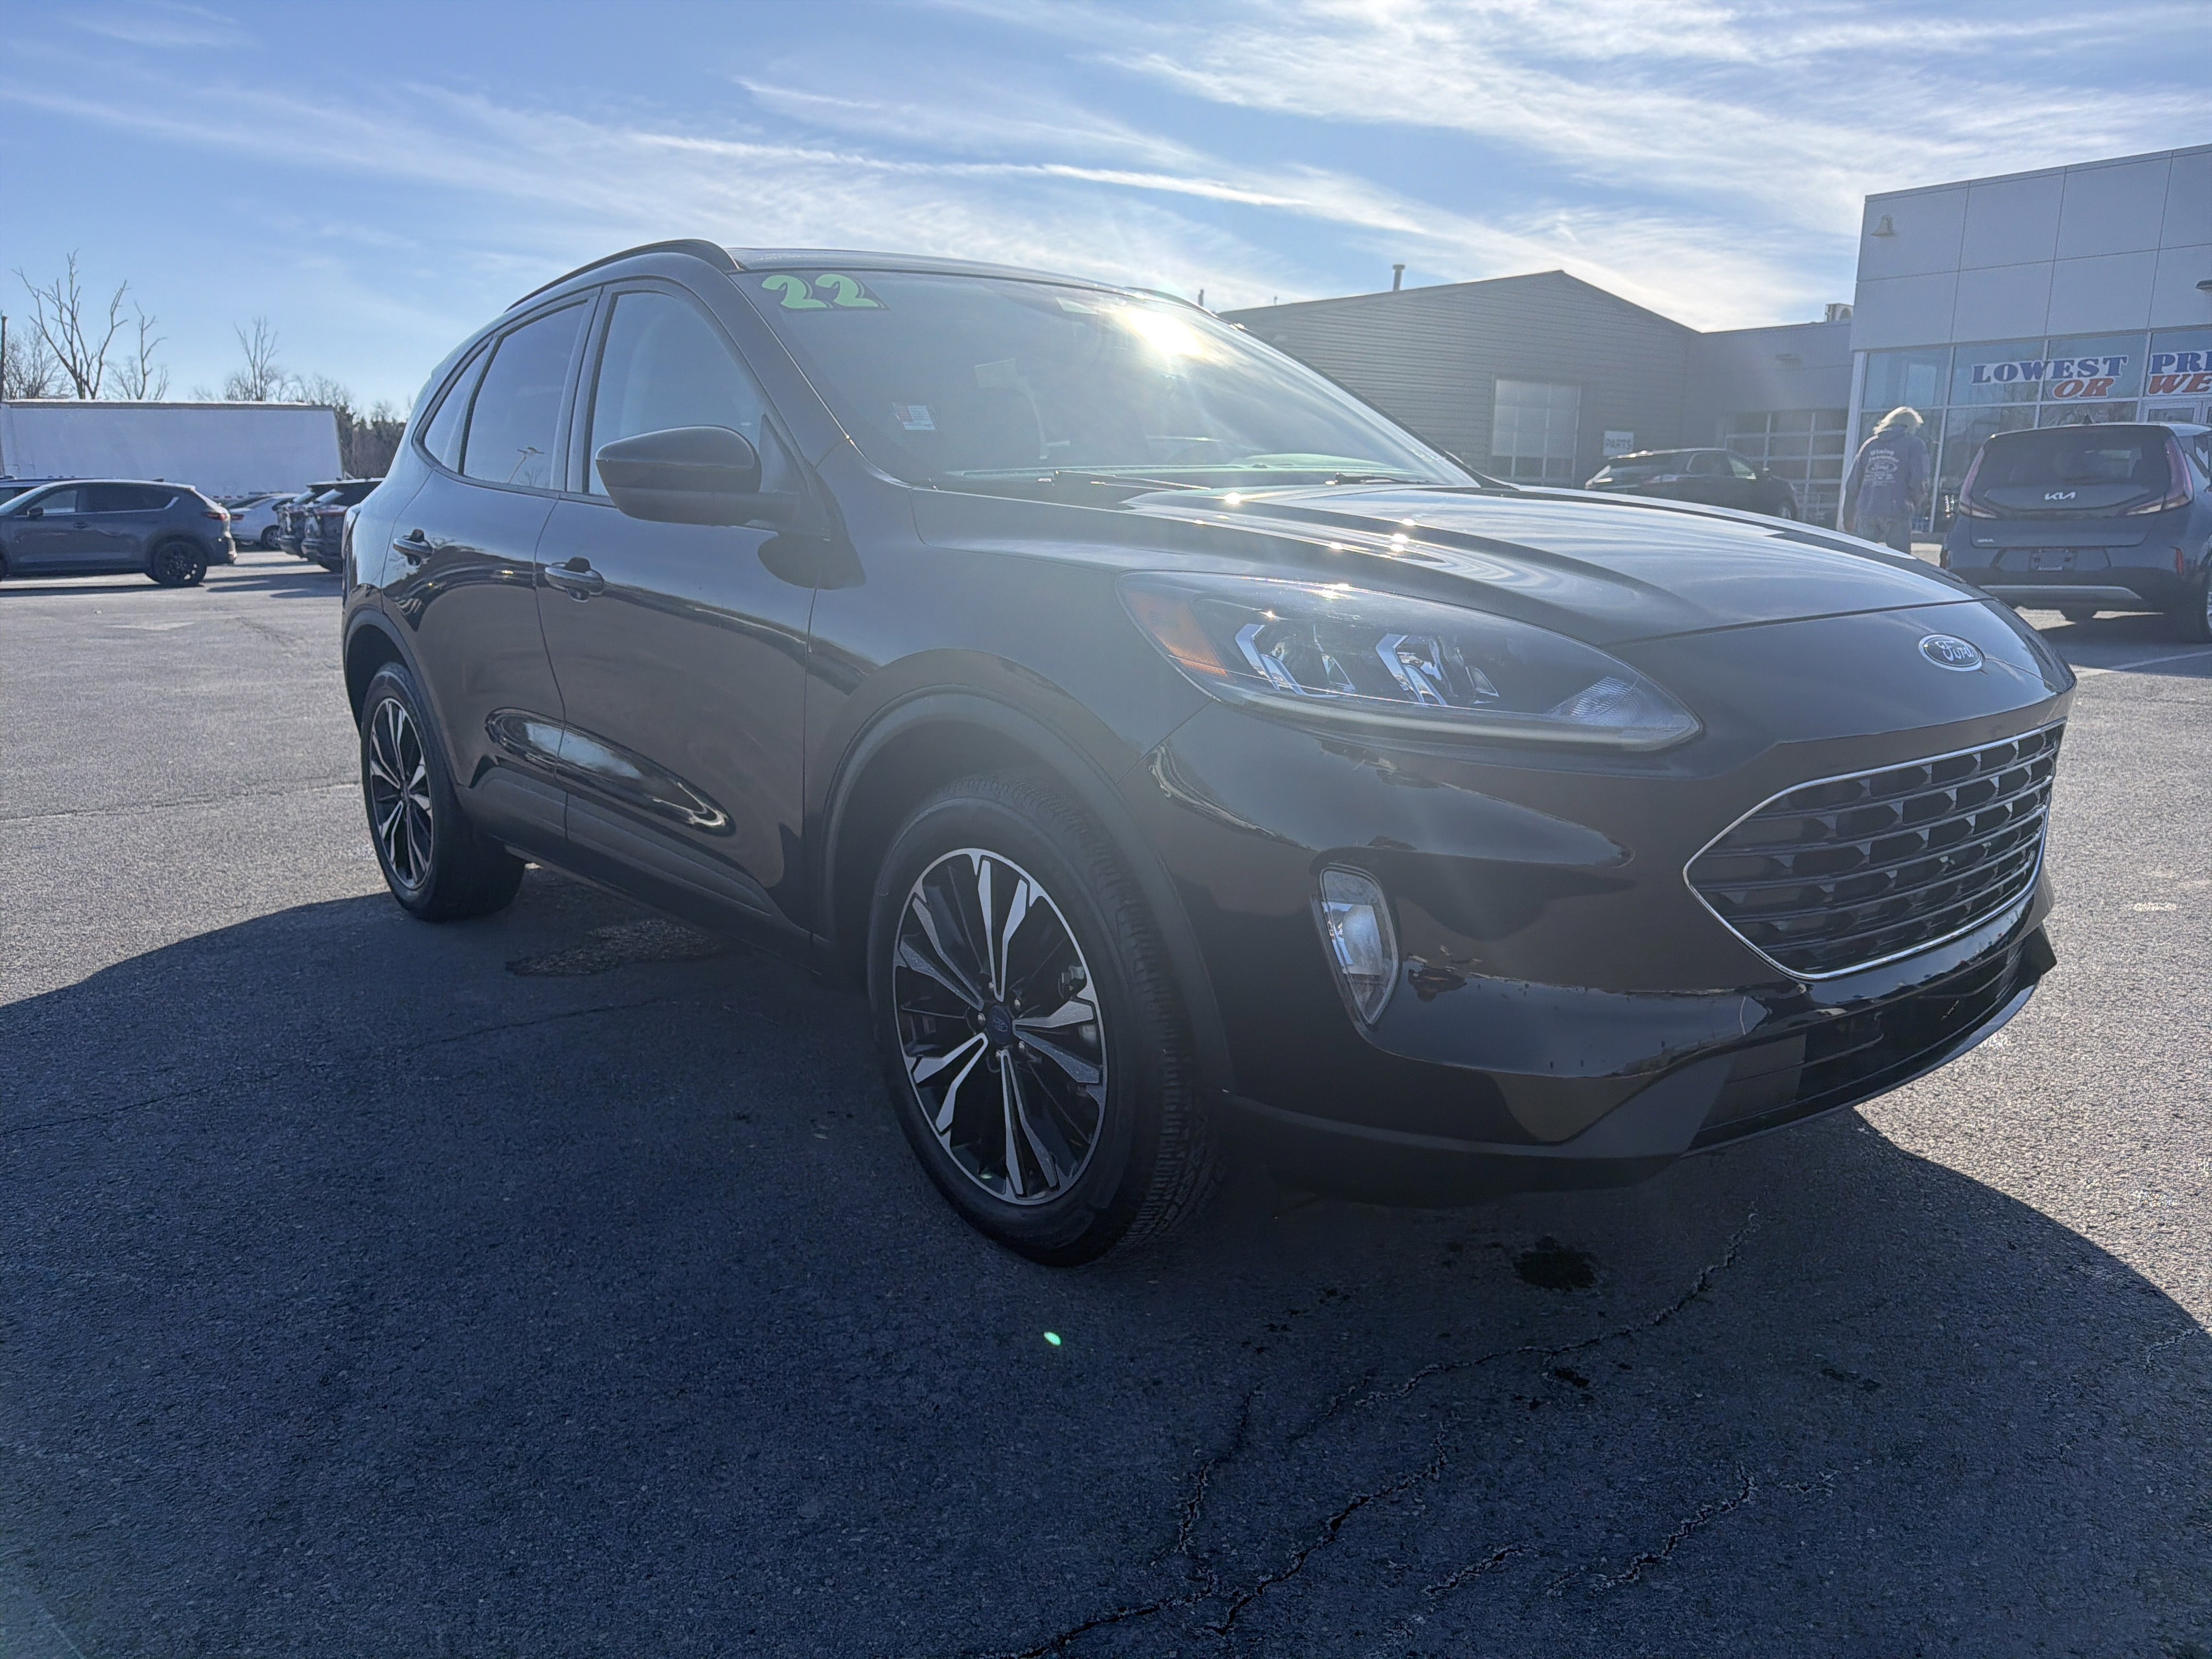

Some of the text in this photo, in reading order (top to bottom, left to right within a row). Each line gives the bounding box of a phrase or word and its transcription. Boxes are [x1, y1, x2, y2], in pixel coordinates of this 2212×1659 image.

[762, 274, 885, 309] 22
[1971, 356, 2128, 383] LOWEST
[2054, 378, 2114, 398] OR
[1934, 640, 1974, 662] Ford
